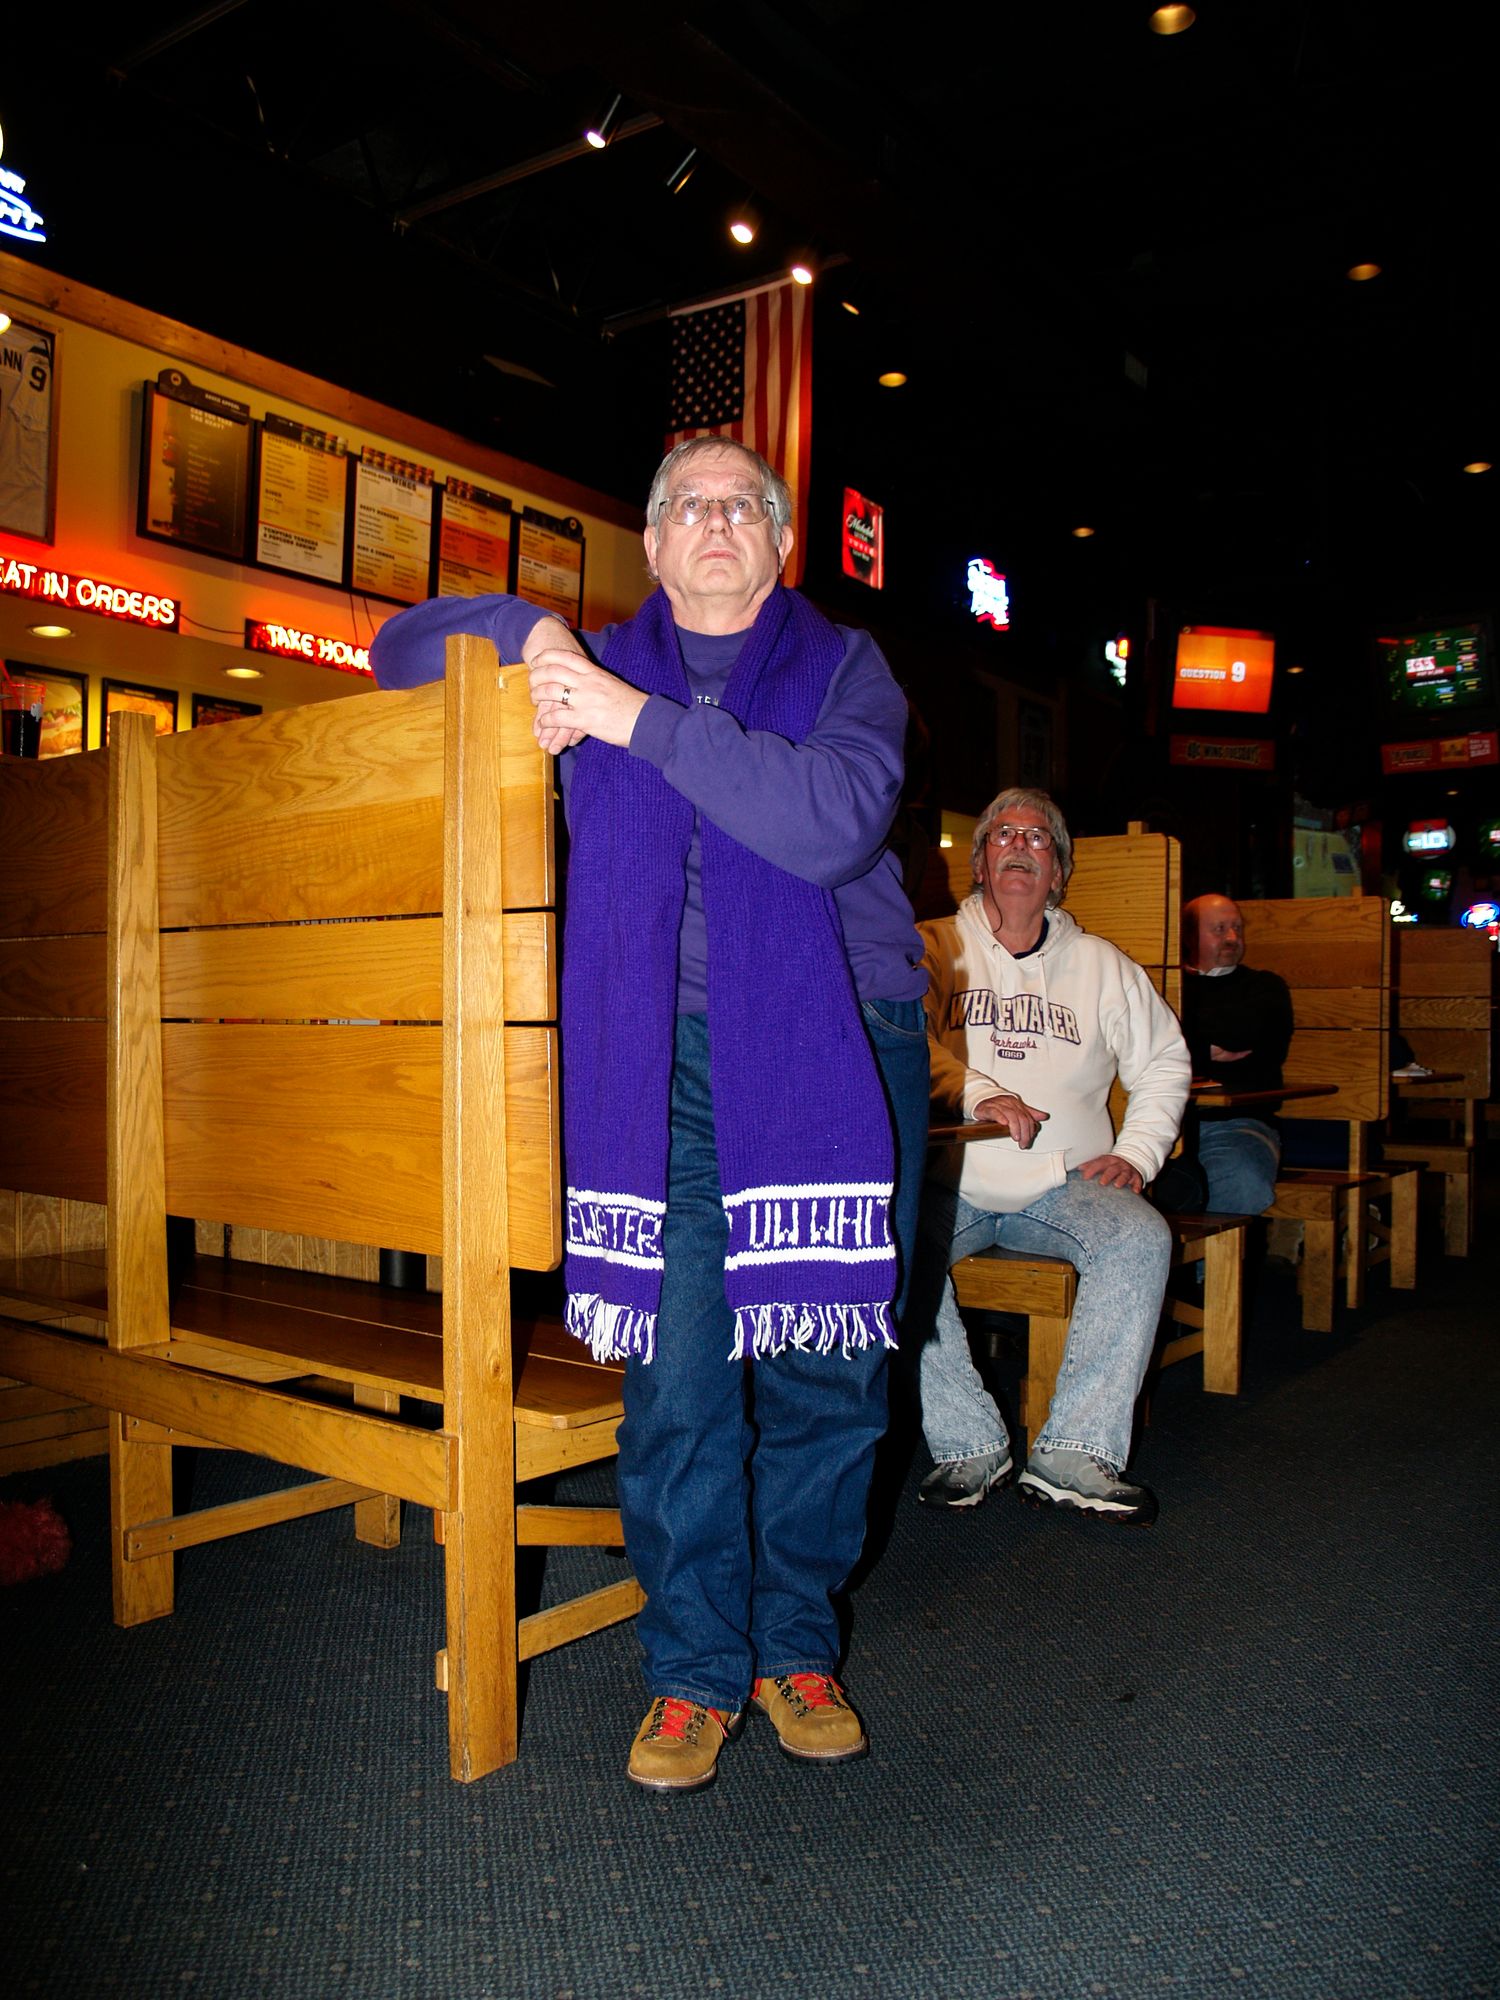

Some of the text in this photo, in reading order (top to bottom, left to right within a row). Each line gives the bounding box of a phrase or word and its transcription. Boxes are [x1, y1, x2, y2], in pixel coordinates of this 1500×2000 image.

[0, 347, 22, 372] NN
[29, 366, 47, 392] 9
[43, 571, 69, 600] IN
[76, 579, 176, 625] ORDERS
[265, 624, 315, 657] TAKE
[1180, 661, 1246, 682] QUESTION 9
[949, 989, 1081, 1045] WHIEWAER
[750, 1200, 799, 1250] UW
